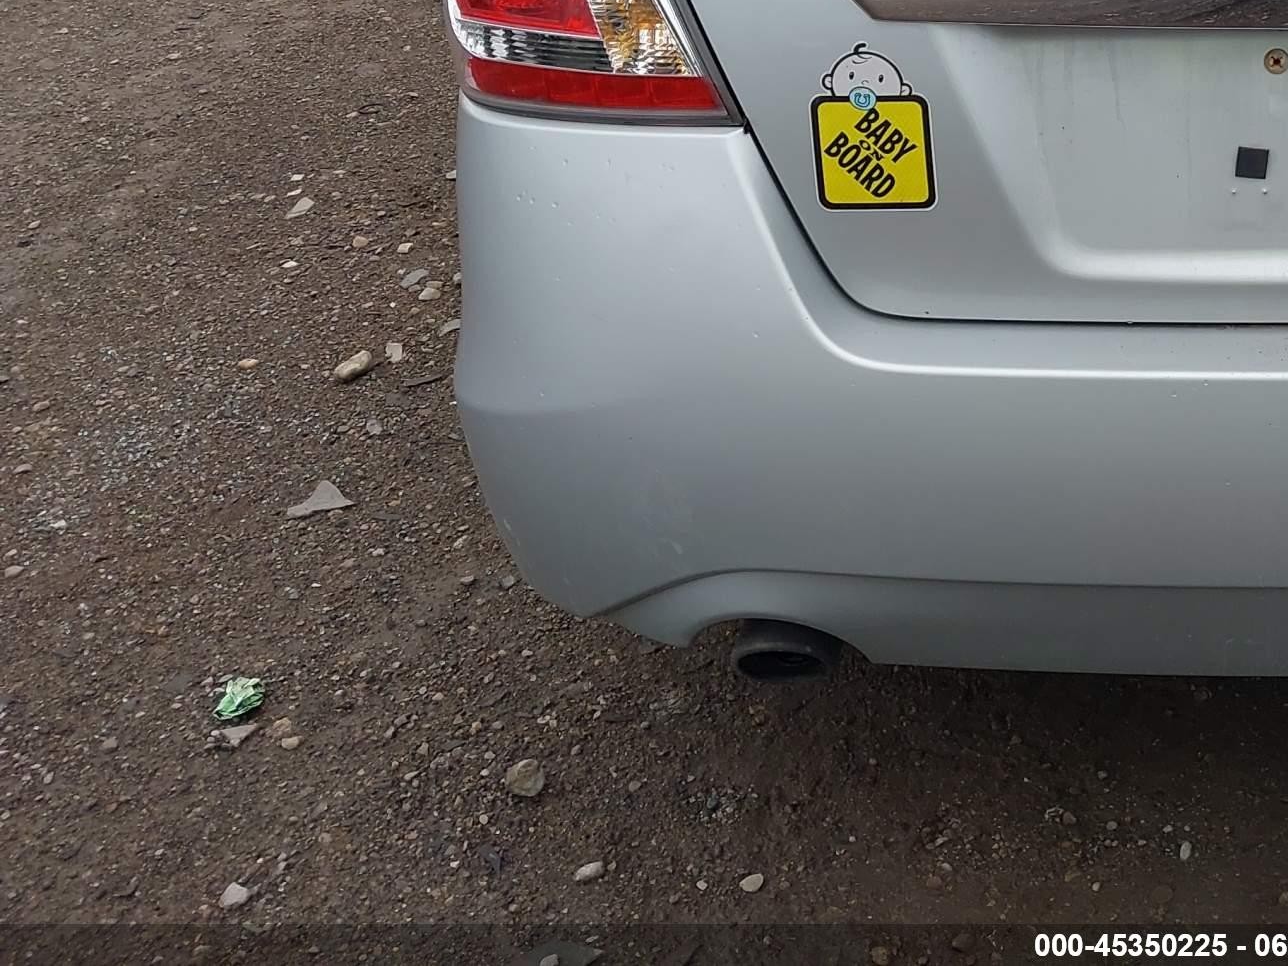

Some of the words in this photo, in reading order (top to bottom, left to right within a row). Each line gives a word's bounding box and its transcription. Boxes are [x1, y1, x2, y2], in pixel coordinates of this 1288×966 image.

[854, 108, 918, 163] BABY
[859, 140, 884, 161] ON
[824, 132, 896, 198] BOARD
